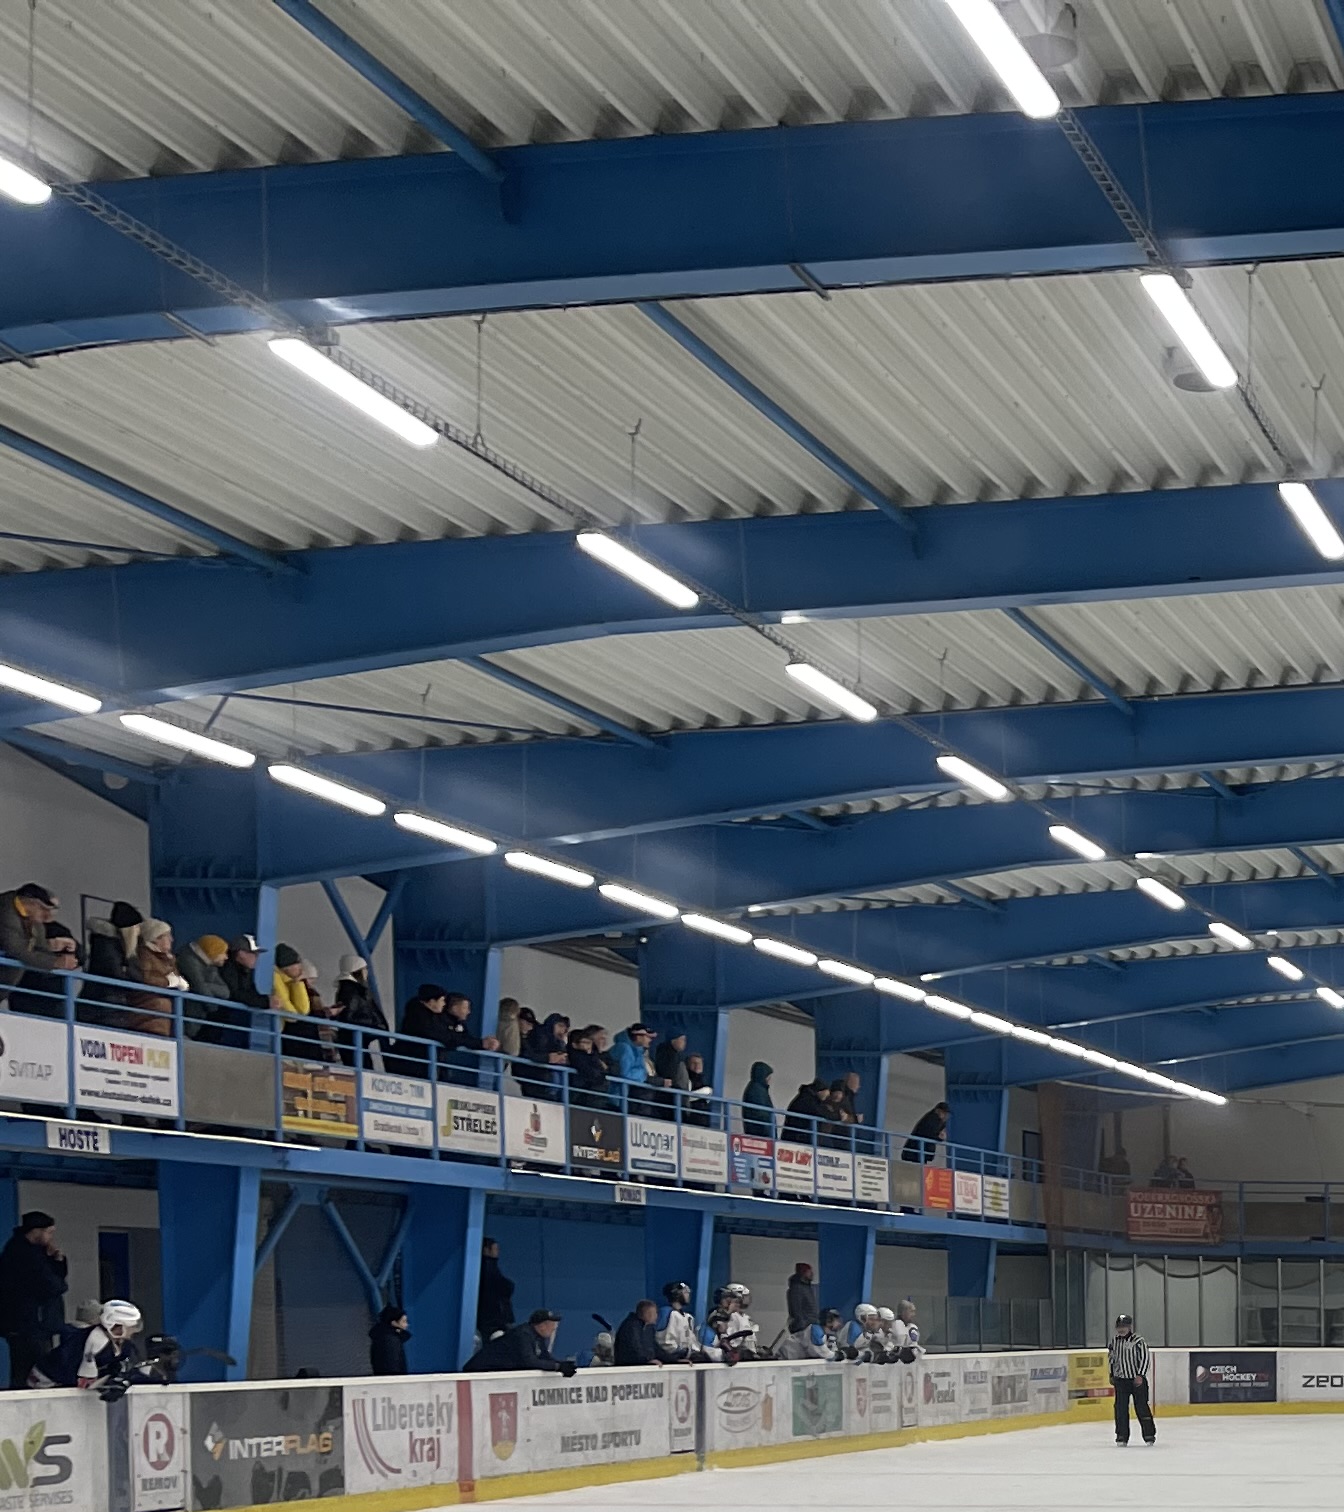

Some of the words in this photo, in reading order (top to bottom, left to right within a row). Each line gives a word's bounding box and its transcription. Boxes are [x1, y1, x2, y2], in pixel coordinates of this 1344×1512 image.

[532, 1386, 582, 1407] LOMNICE
[586, 1384, 608, 1403] NAD
[611, 1382, 664, 1402] POPELKOU
[371, 1393, 455, 1432] Liberecký
[229, 1432, 333, 1460] INTERFLAG
[408, 1430, 441, 1470] kraj
[601, 1429, 641, 1450] SPORTU
